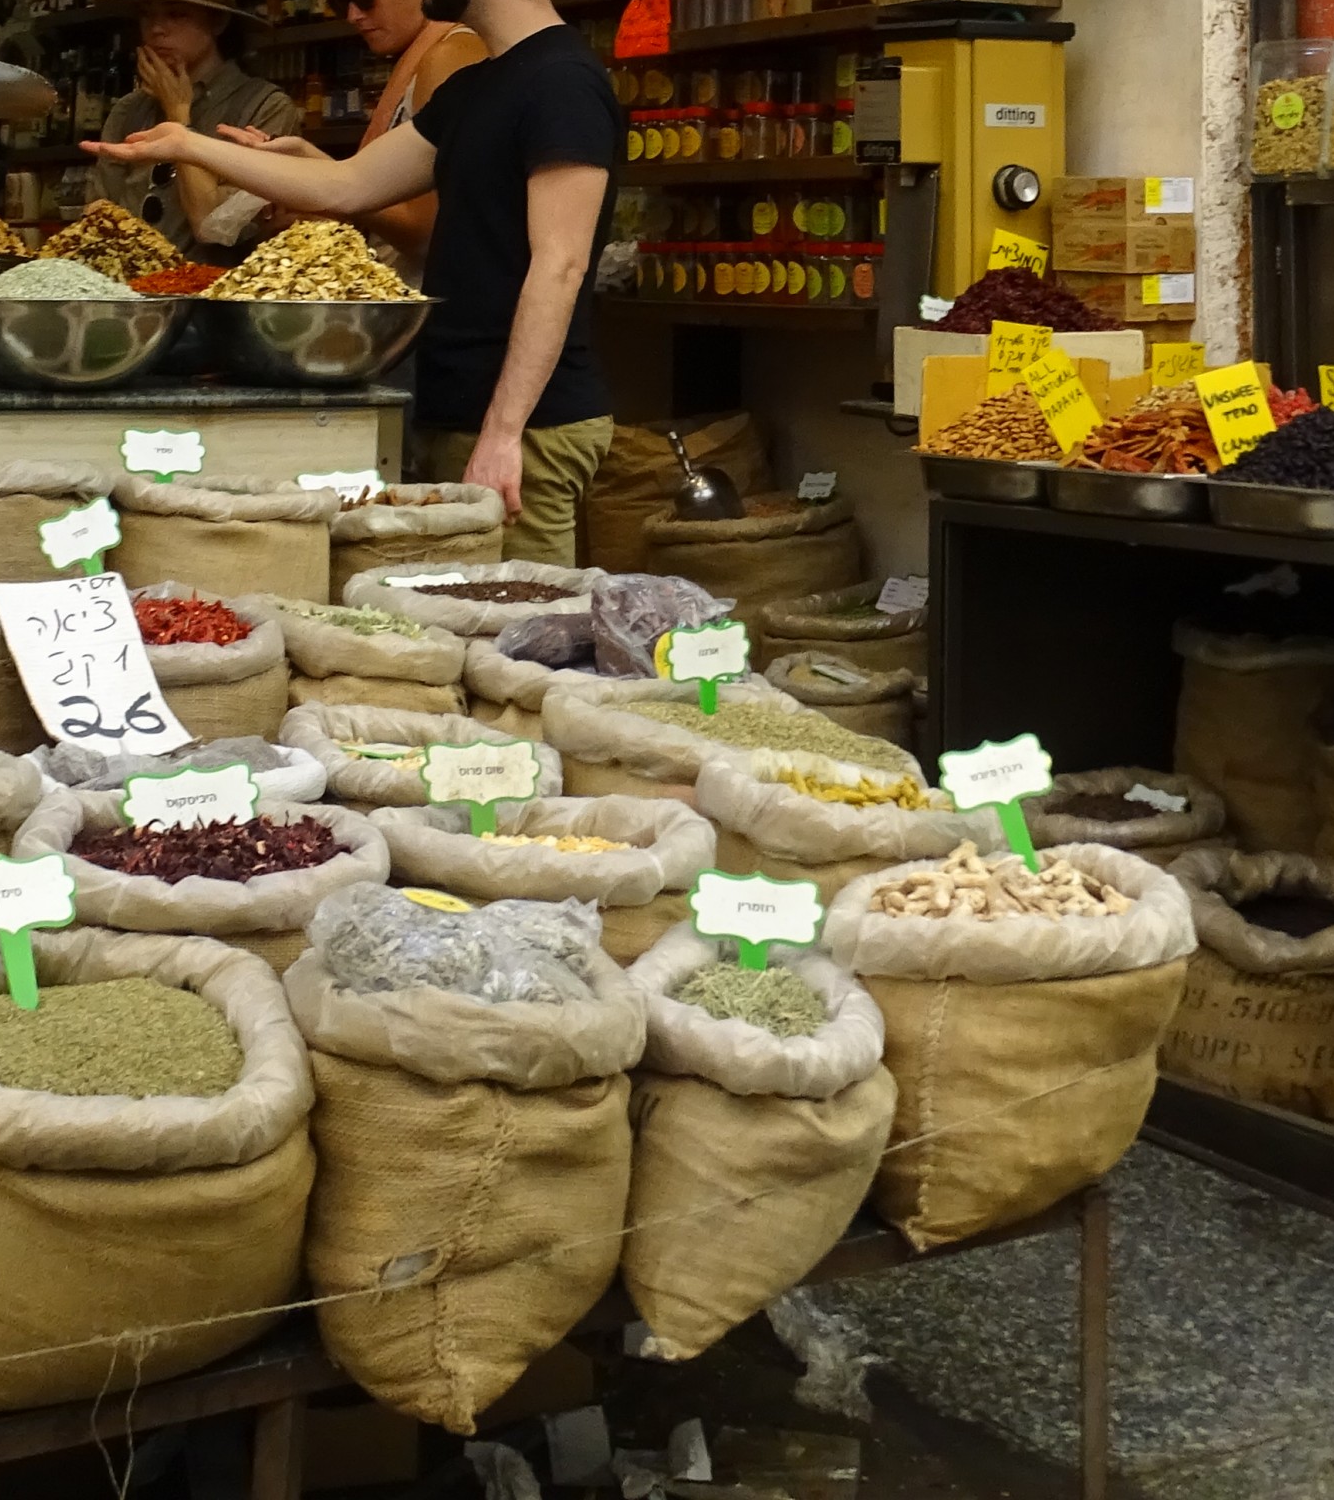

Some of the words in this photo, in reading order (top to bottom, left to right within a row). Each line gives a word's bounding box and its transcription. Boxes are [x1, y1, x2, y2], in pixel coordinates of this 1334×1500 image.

[996, 109, 1035, 124] ditting
[58, 691, 167, 739] 26
[166, 793, 218, 809] היביסקוס
[737, 899, 776, 914] רוזמרין
